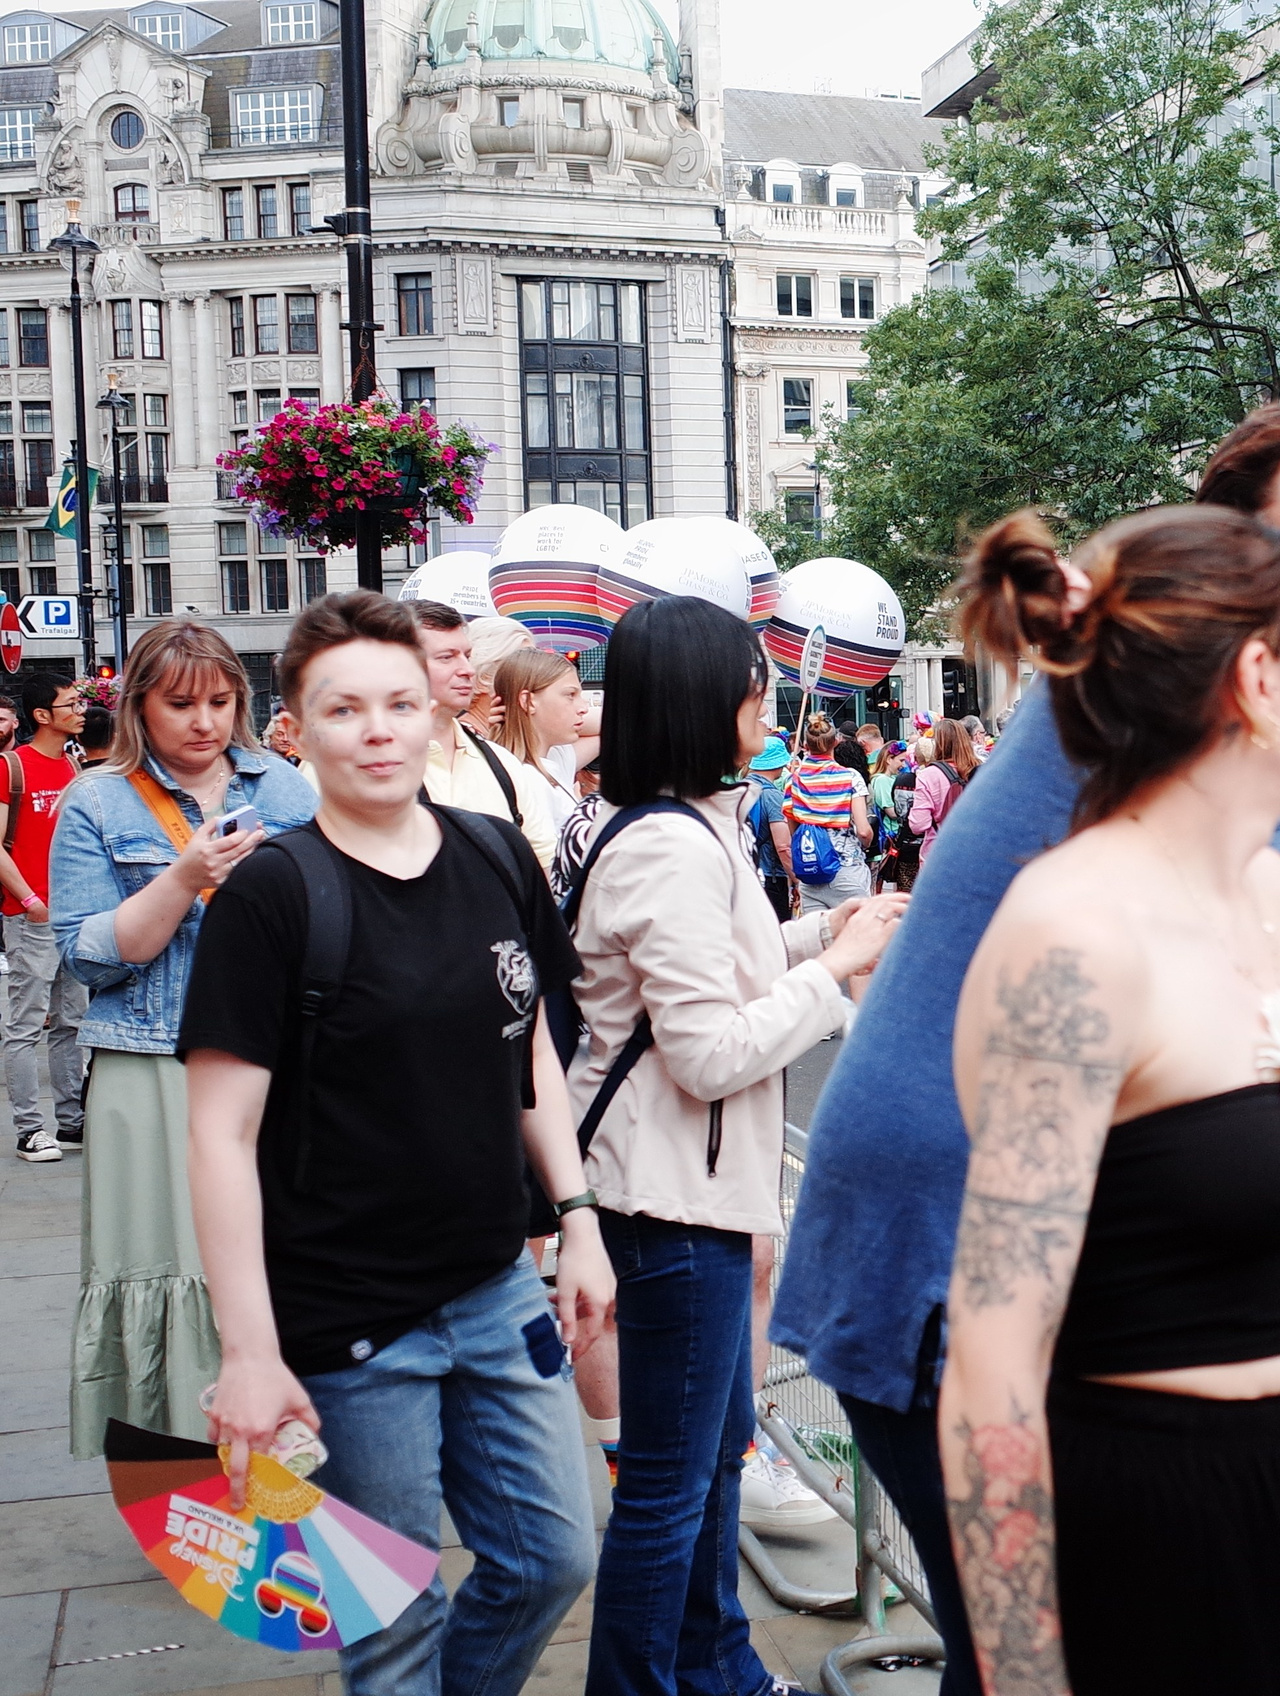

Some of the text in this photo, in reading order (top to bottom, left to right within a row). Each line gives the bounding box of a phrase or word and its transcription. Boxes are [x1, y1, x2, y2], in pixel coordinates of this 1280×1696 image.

[49, 602, 67, 624] P
[877, 601, 888, 614] WE
[877, 614, 898, 628] STAND
[41, 627, 76, 635] Trafalgar
[876, 626, 899, 640] PROUD
[188, 1505, 225, 1524] IRELAND
[233, 1525, 244, 1536] UK
[165, 1511, 257, 1571] PRIDE
